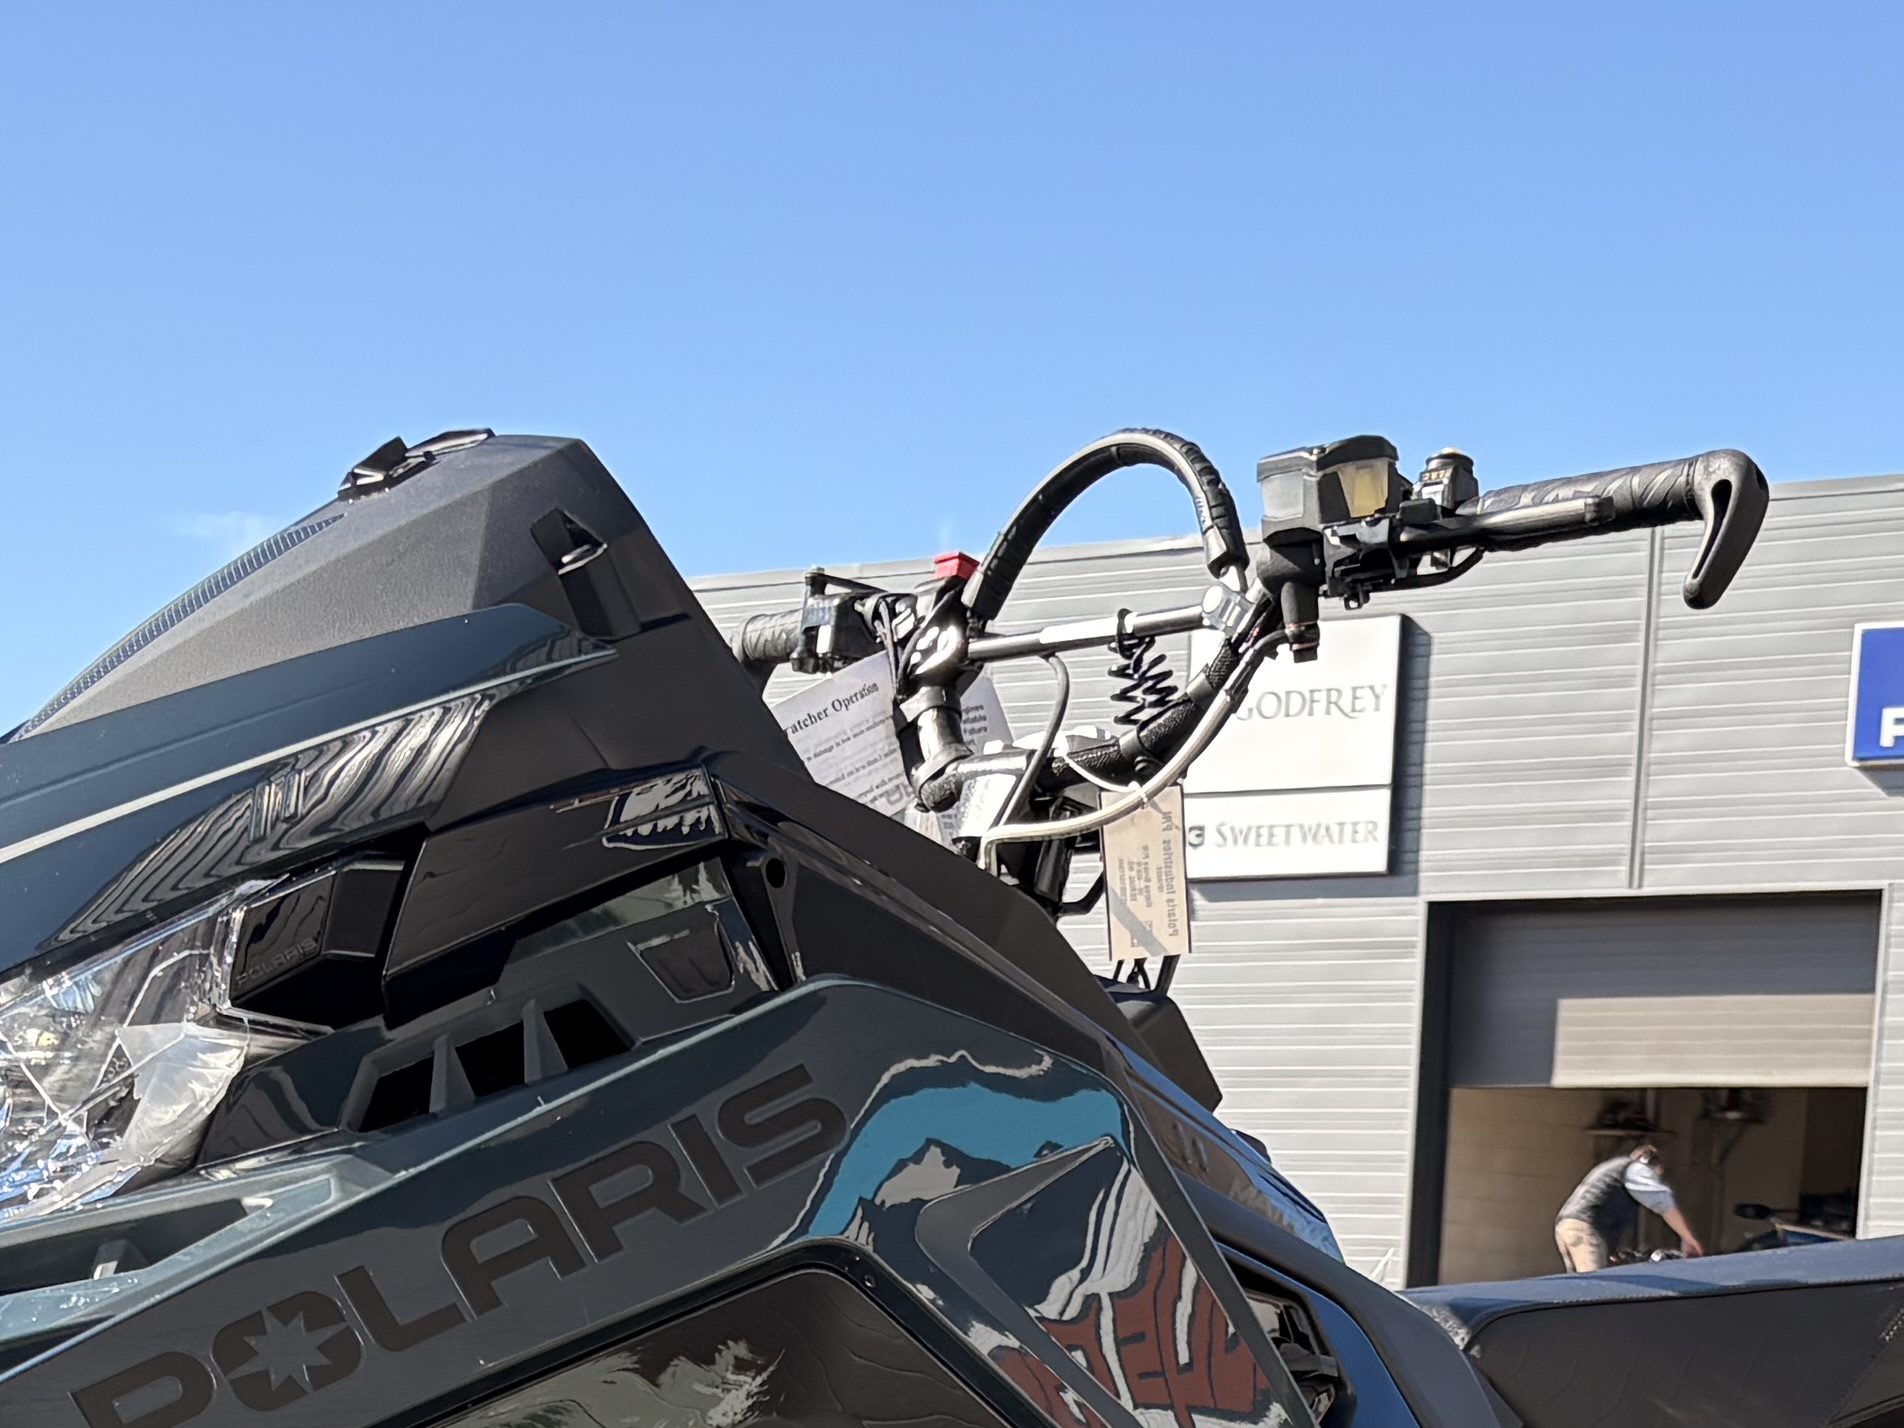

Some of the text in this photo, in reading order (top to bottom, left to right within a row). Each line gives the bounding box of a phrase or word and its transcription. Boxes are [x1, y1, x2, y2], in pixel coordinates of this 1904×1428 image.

[831, 682, 880, 712] Operation
[1214, 819, 1380, 848] SWEETWATER
[236, 936, 318, 985] POLARIS
